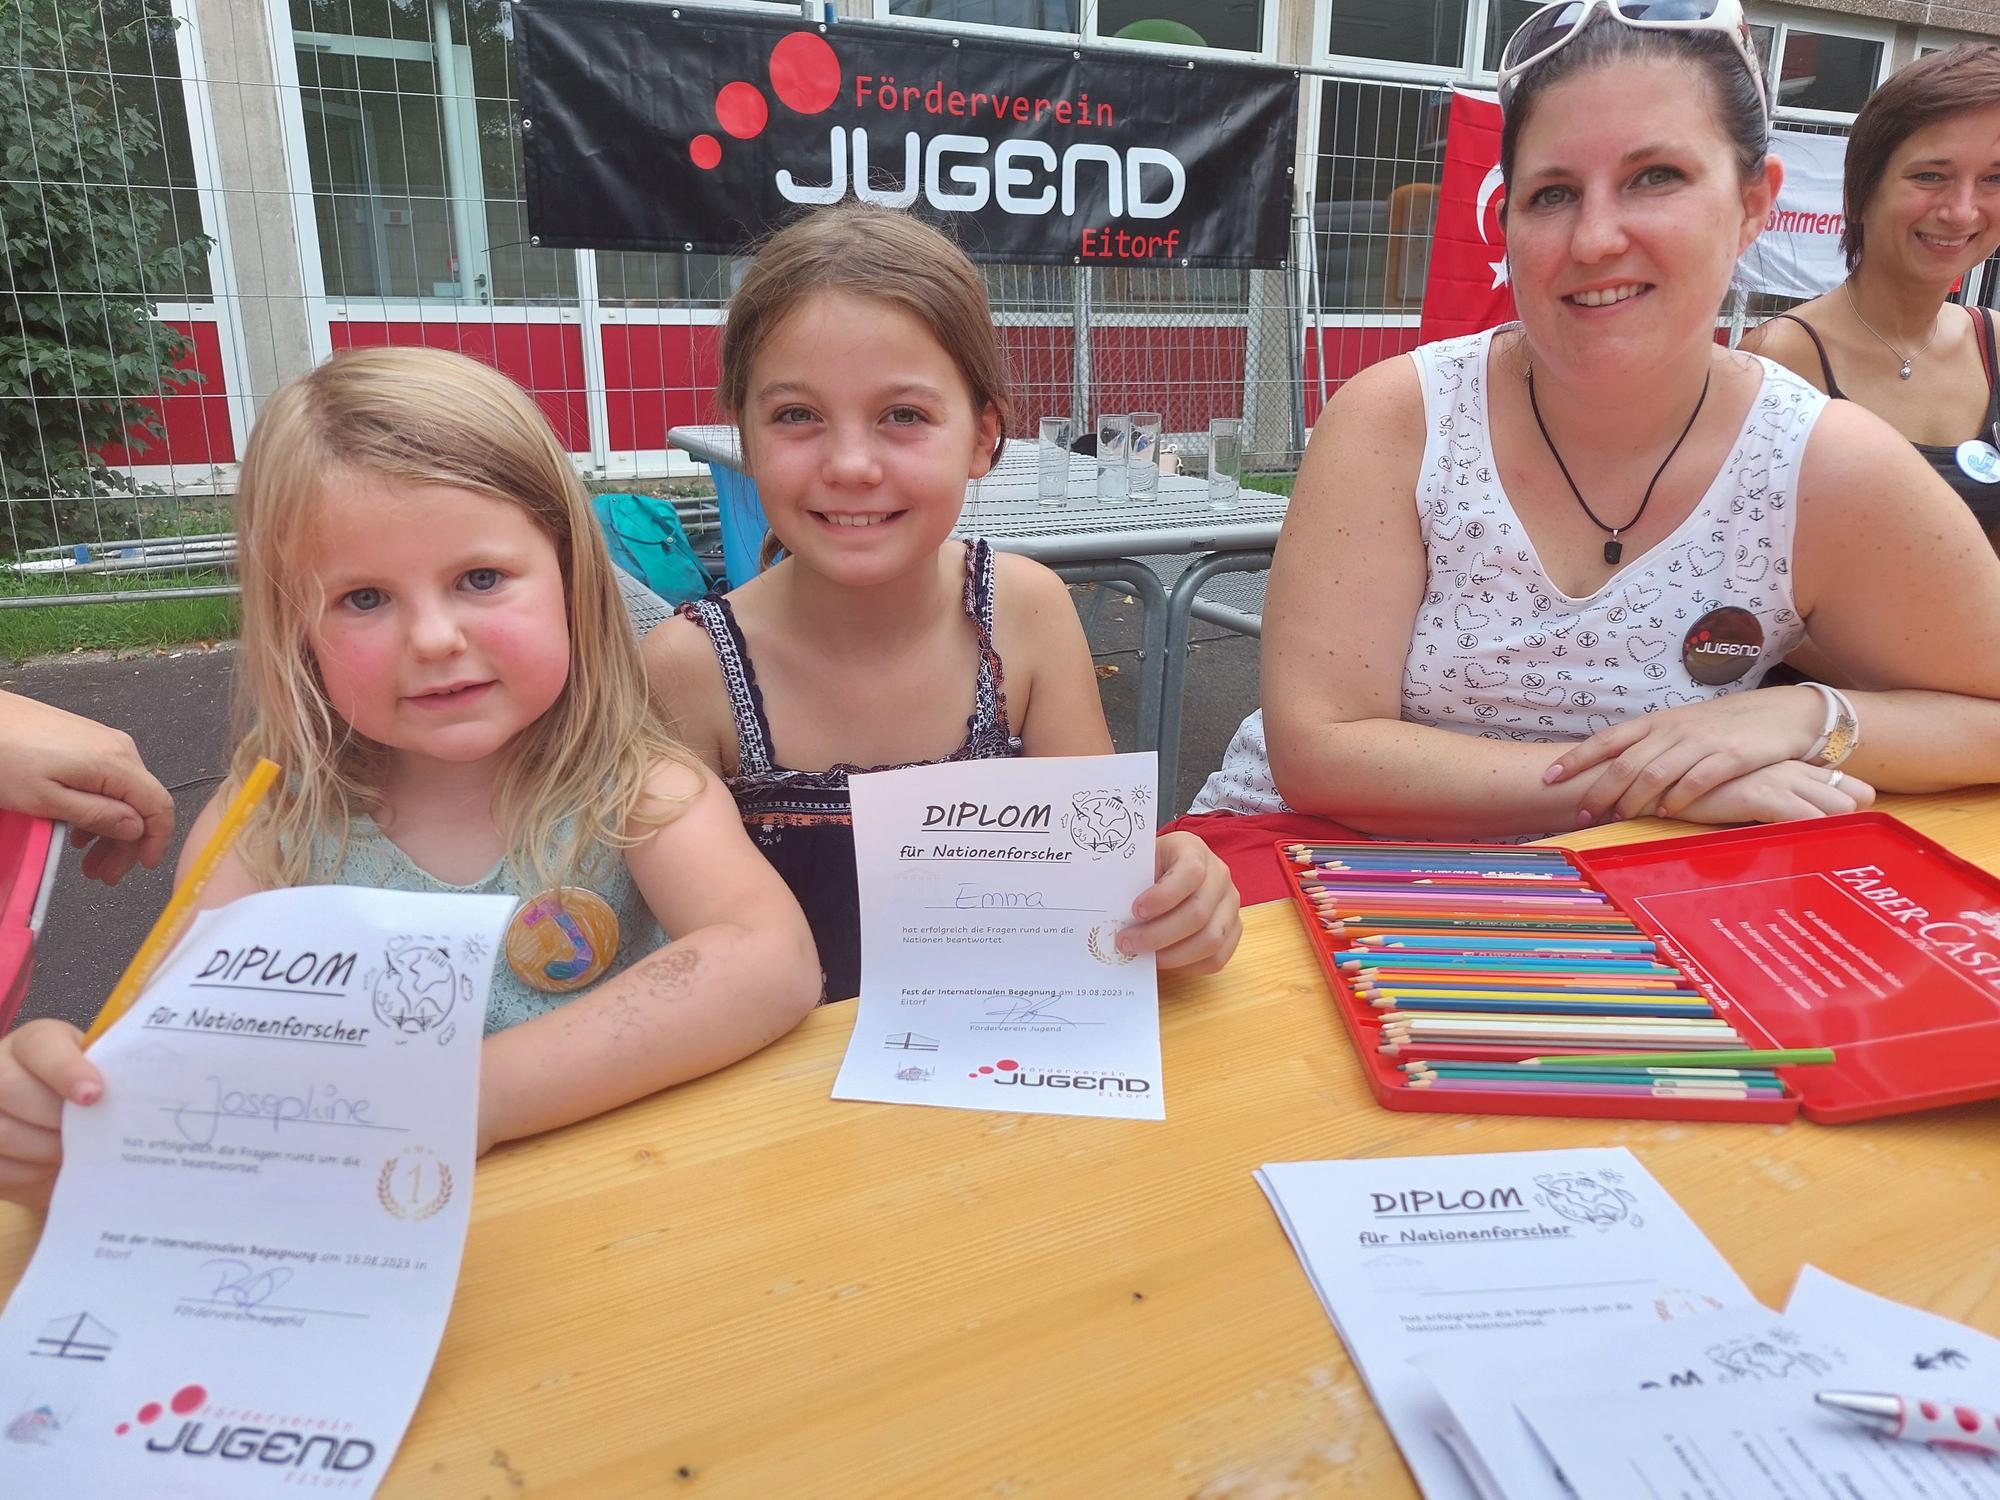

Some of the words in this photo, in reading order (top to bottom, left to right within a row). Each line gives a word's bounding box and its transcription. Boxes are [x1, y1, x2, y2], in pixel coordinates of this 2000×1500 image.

[855, 75, 1114, 127] Förderverein
[775, 125, 1186, 220] JUGEND
[1082, 228, 1181, 259] Eitorf
[1695, 642, 1761, 657] JUGEND
[922, 801, 1052, 828] DIPLOM
[900, 845, 924, 858] für
[933, 844, 1072, 861] Nationenforscher
[955, 883, 1045, 910] Emma
[902, 926, 918, 934] hat
[920, 926, 968, 935] erfolgreich
[970, 926, 984, 934] die
[986, 926, 1017, 935] Fragen
[1019, 926, 1041, 934] rund
[1060, 926, 1074, 934] die
[902, 936, 943, 944] Nationen
[946, 936, 1005, 944] beantwortet.
[195, 945, 358, 986] DIPLOM
[901, 988, 919, 996] Fest
[922, 988, 935, 996] der
[938, 988, 1006, 996] Internationalen
[1008, 988, 1056, 998] Begegnung
[901, 998, 927, 1006] Eitorf
[147, 1006, 177, 1025] für
[185, 1007, 370, 1042] Nationenforscher
[1030, 1025, 1063, 1033] Jugend
[994, 1073, 1150, 1093] JUGEND
[1370, 1187, 1524, 1214] DIPLOM
[1359, 1231, 1390, 1245] für
[1400, 1222, 1571, 1243] Nationenforscher
[145, 1419, 377, 1473] JUGEND
